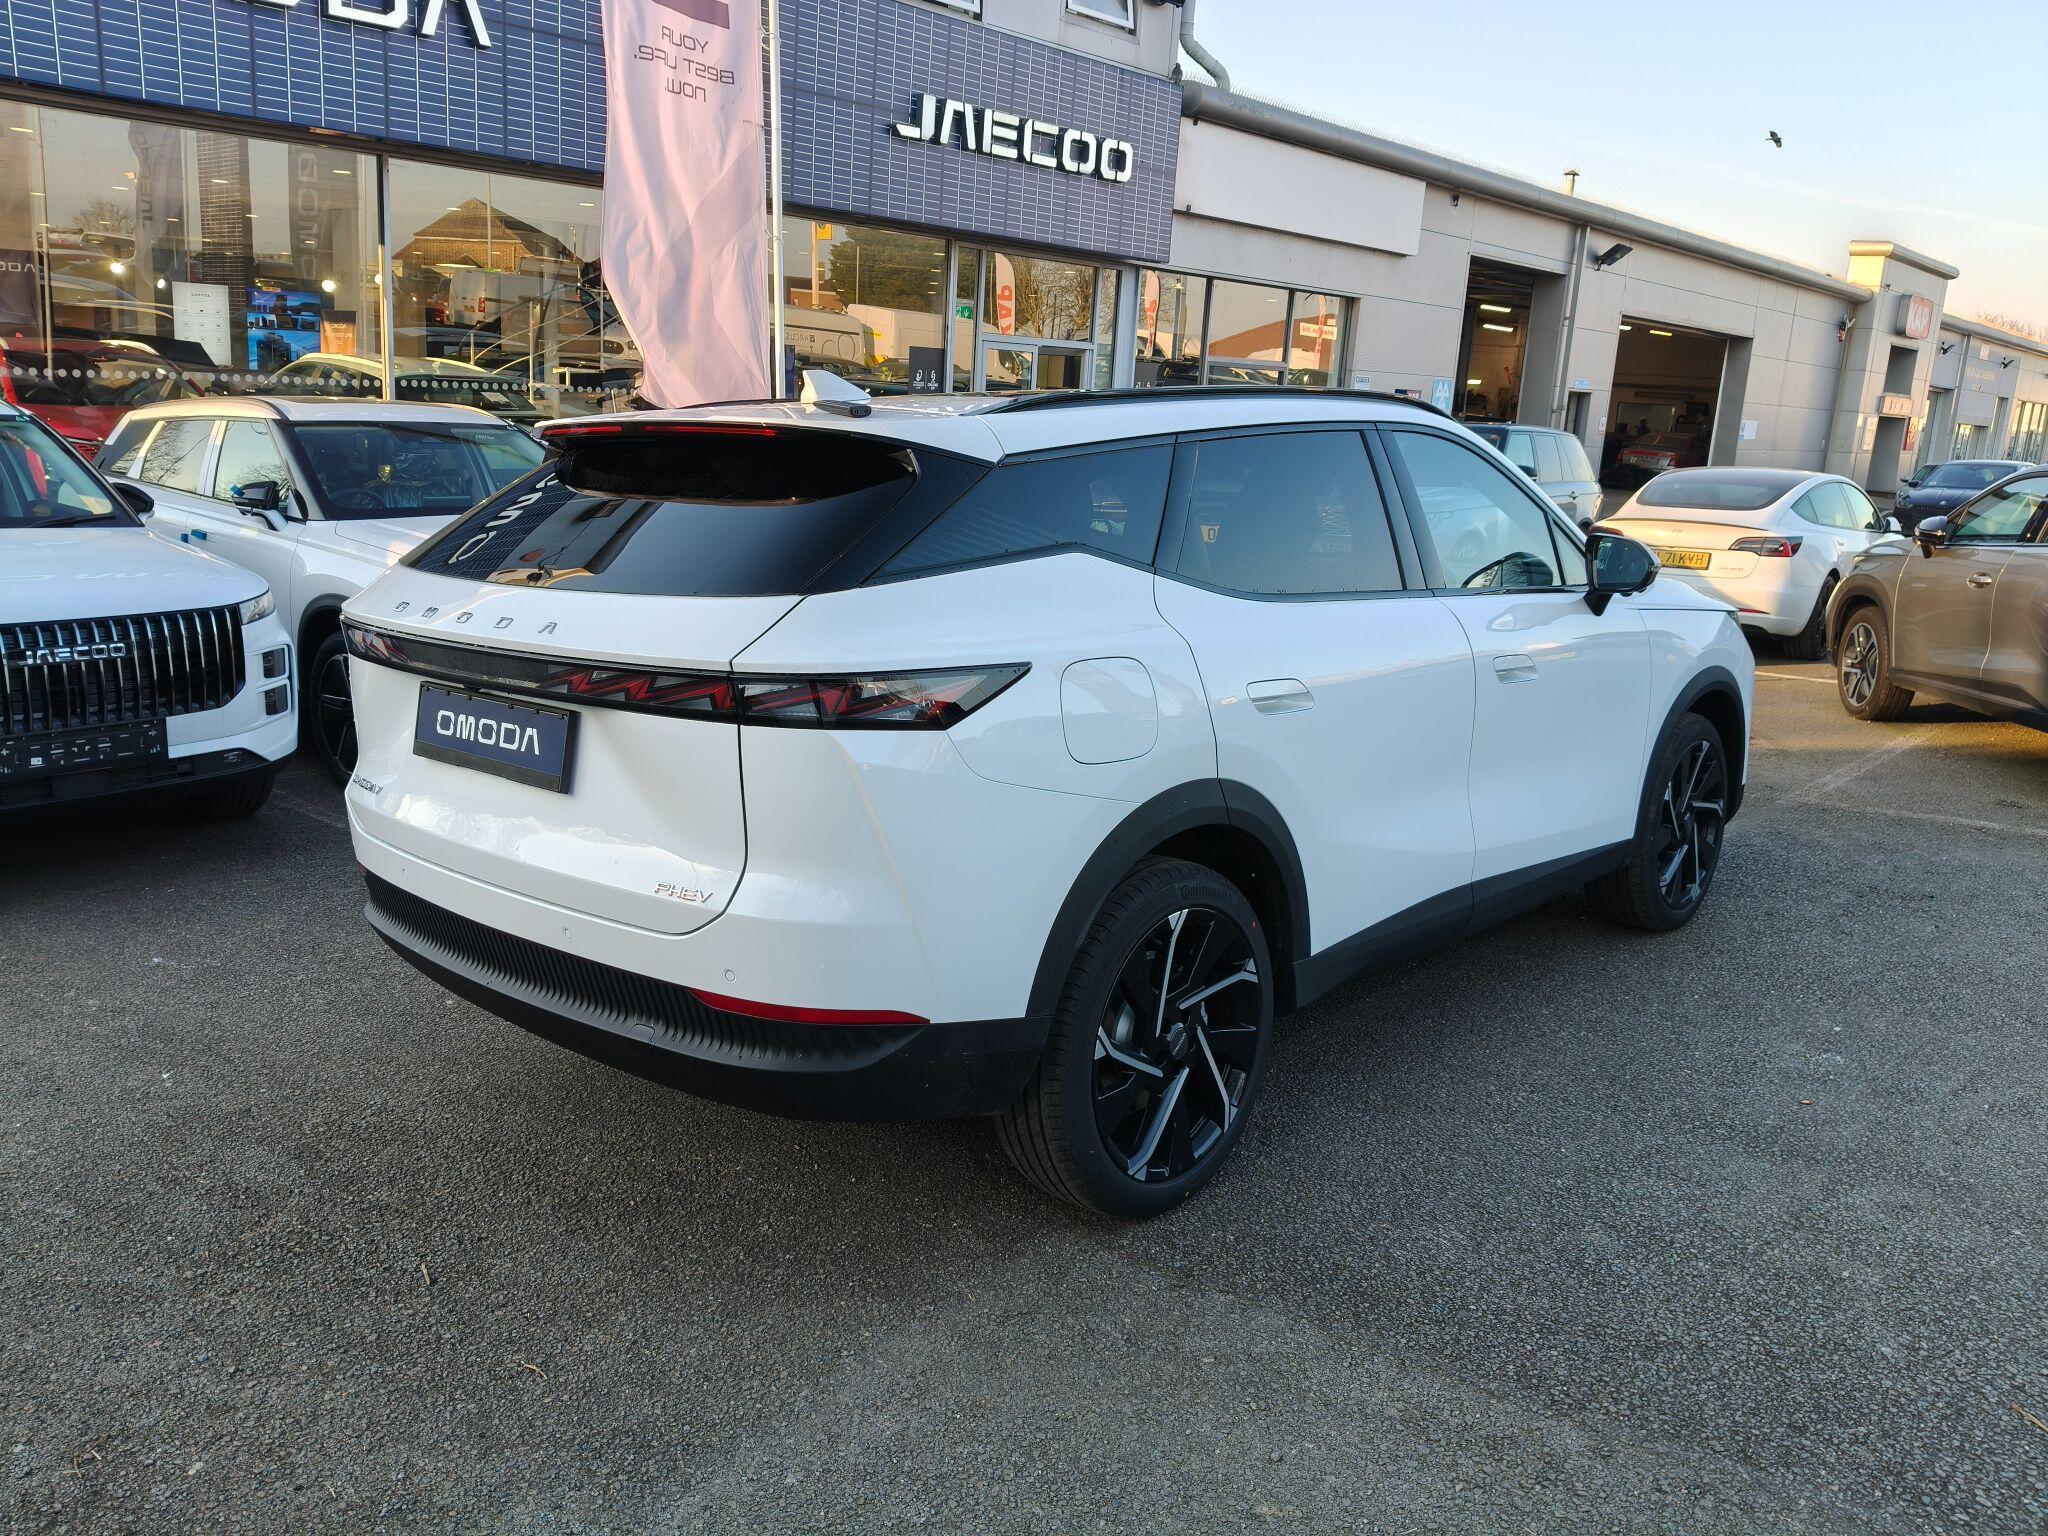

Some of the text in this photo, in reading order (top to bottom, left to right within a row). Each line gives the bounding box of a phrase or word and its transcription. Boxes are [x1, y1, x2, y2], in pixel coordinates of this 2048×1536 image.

[893, 92, 1134, 183] JAECOO
[393, 601, 558, 635] OMODA
[17, 642, 126, 665] JAECOO
[436, 709, 540, 756] OMODA
[654, 882, 714, 903] PHEV
